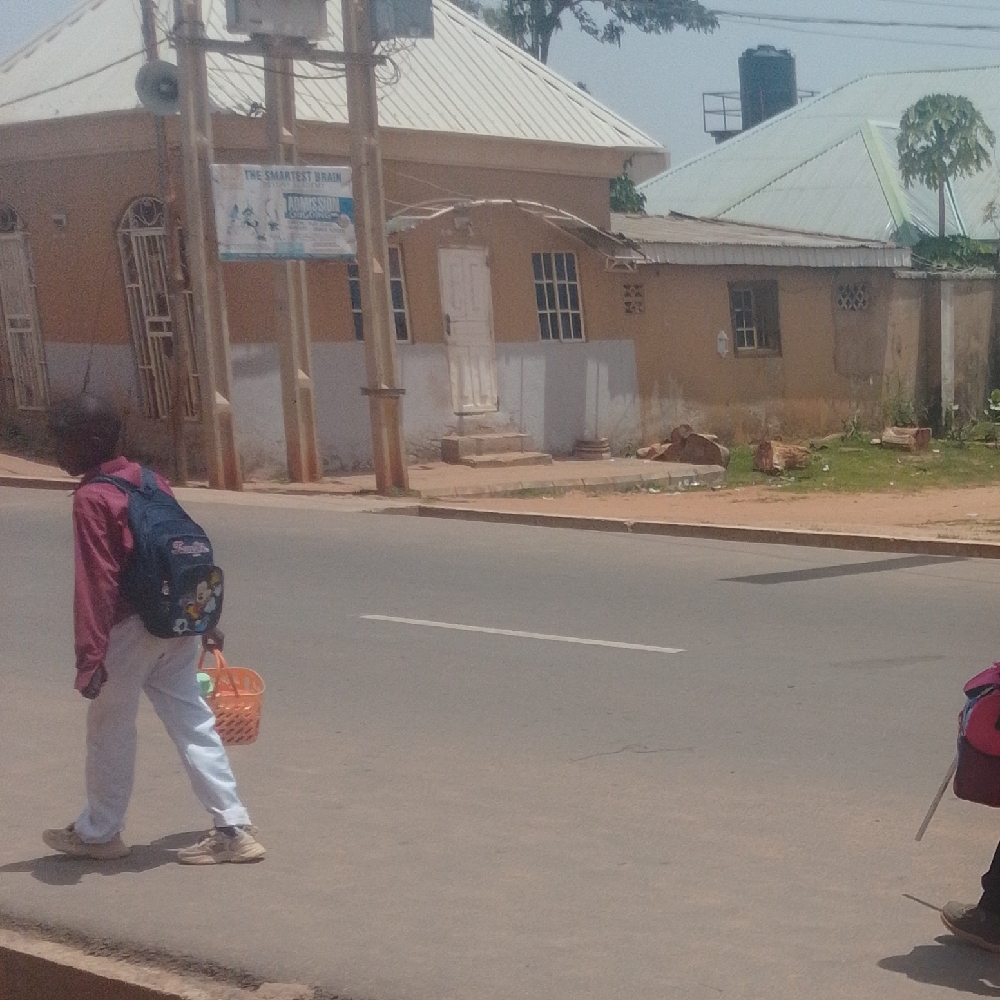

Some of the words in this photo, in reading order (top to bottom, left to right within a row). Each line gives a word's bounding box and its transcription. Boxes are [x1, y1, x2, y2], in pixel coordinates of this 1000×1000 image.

[244, 169, 262, 181] THE
[264, 169, 311, 182] SMARTEST
[313, 171, 342, 183] BRAIN
[288, 196, 339, 211] ADMISSION
